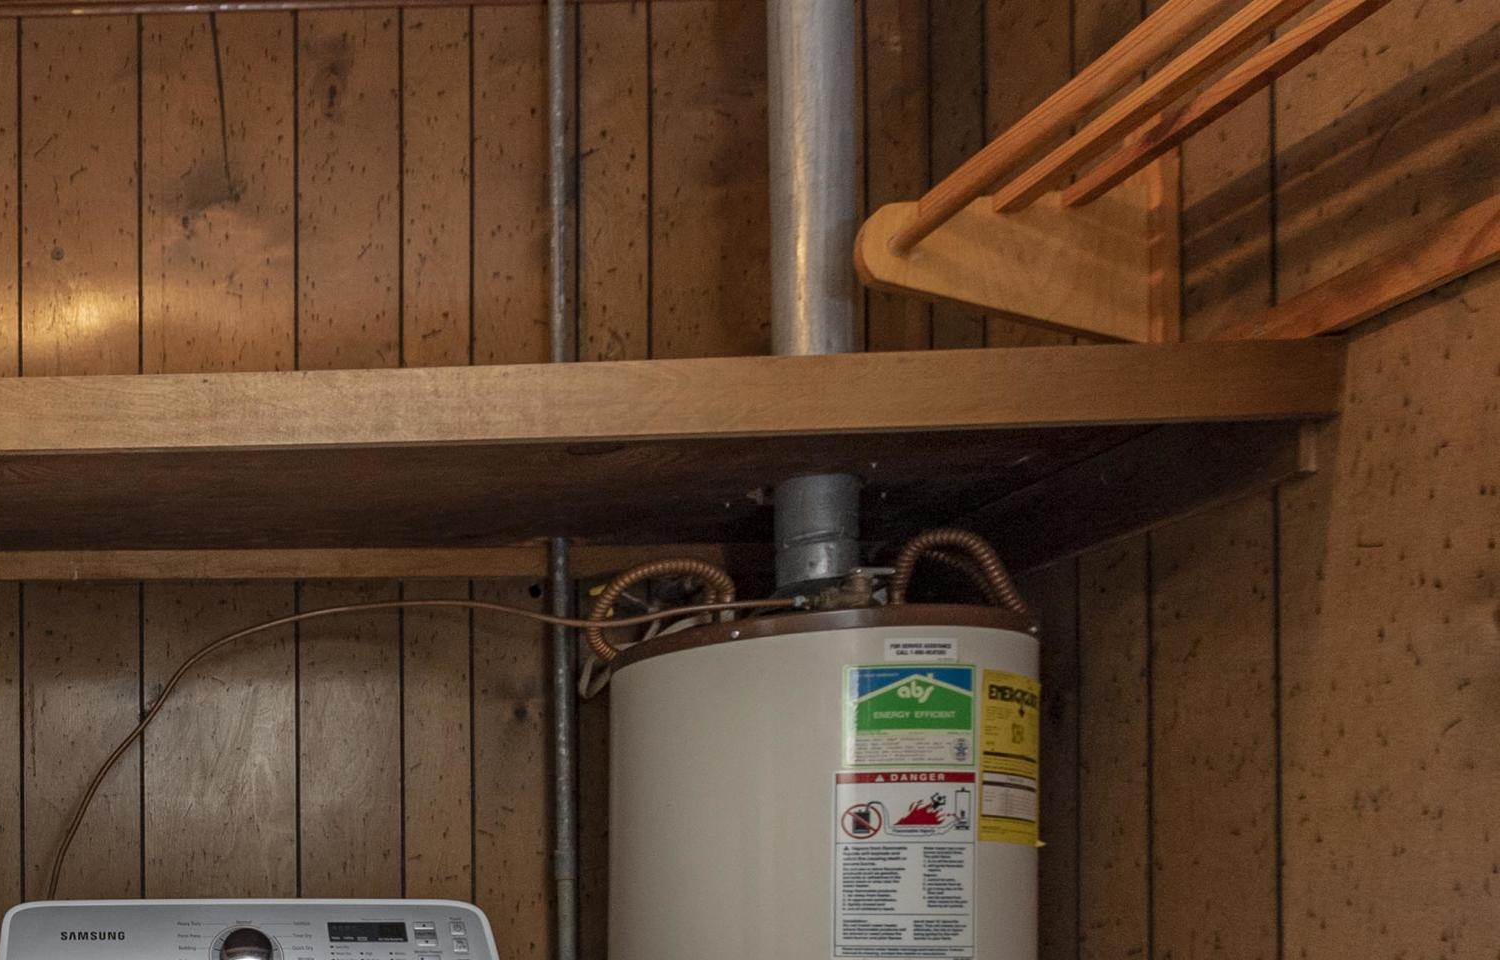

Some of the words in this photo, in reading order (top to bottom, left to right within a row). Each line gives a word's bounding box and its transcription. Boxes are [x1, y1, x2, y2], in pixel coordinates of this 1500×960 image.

[873, 711, 910, 719] ENERGY
[914, 711, 956, 719] EFFICIENT
[890, 773, 945, 782] DANGER
[60, 931, 126, 941] SAMSUNG
